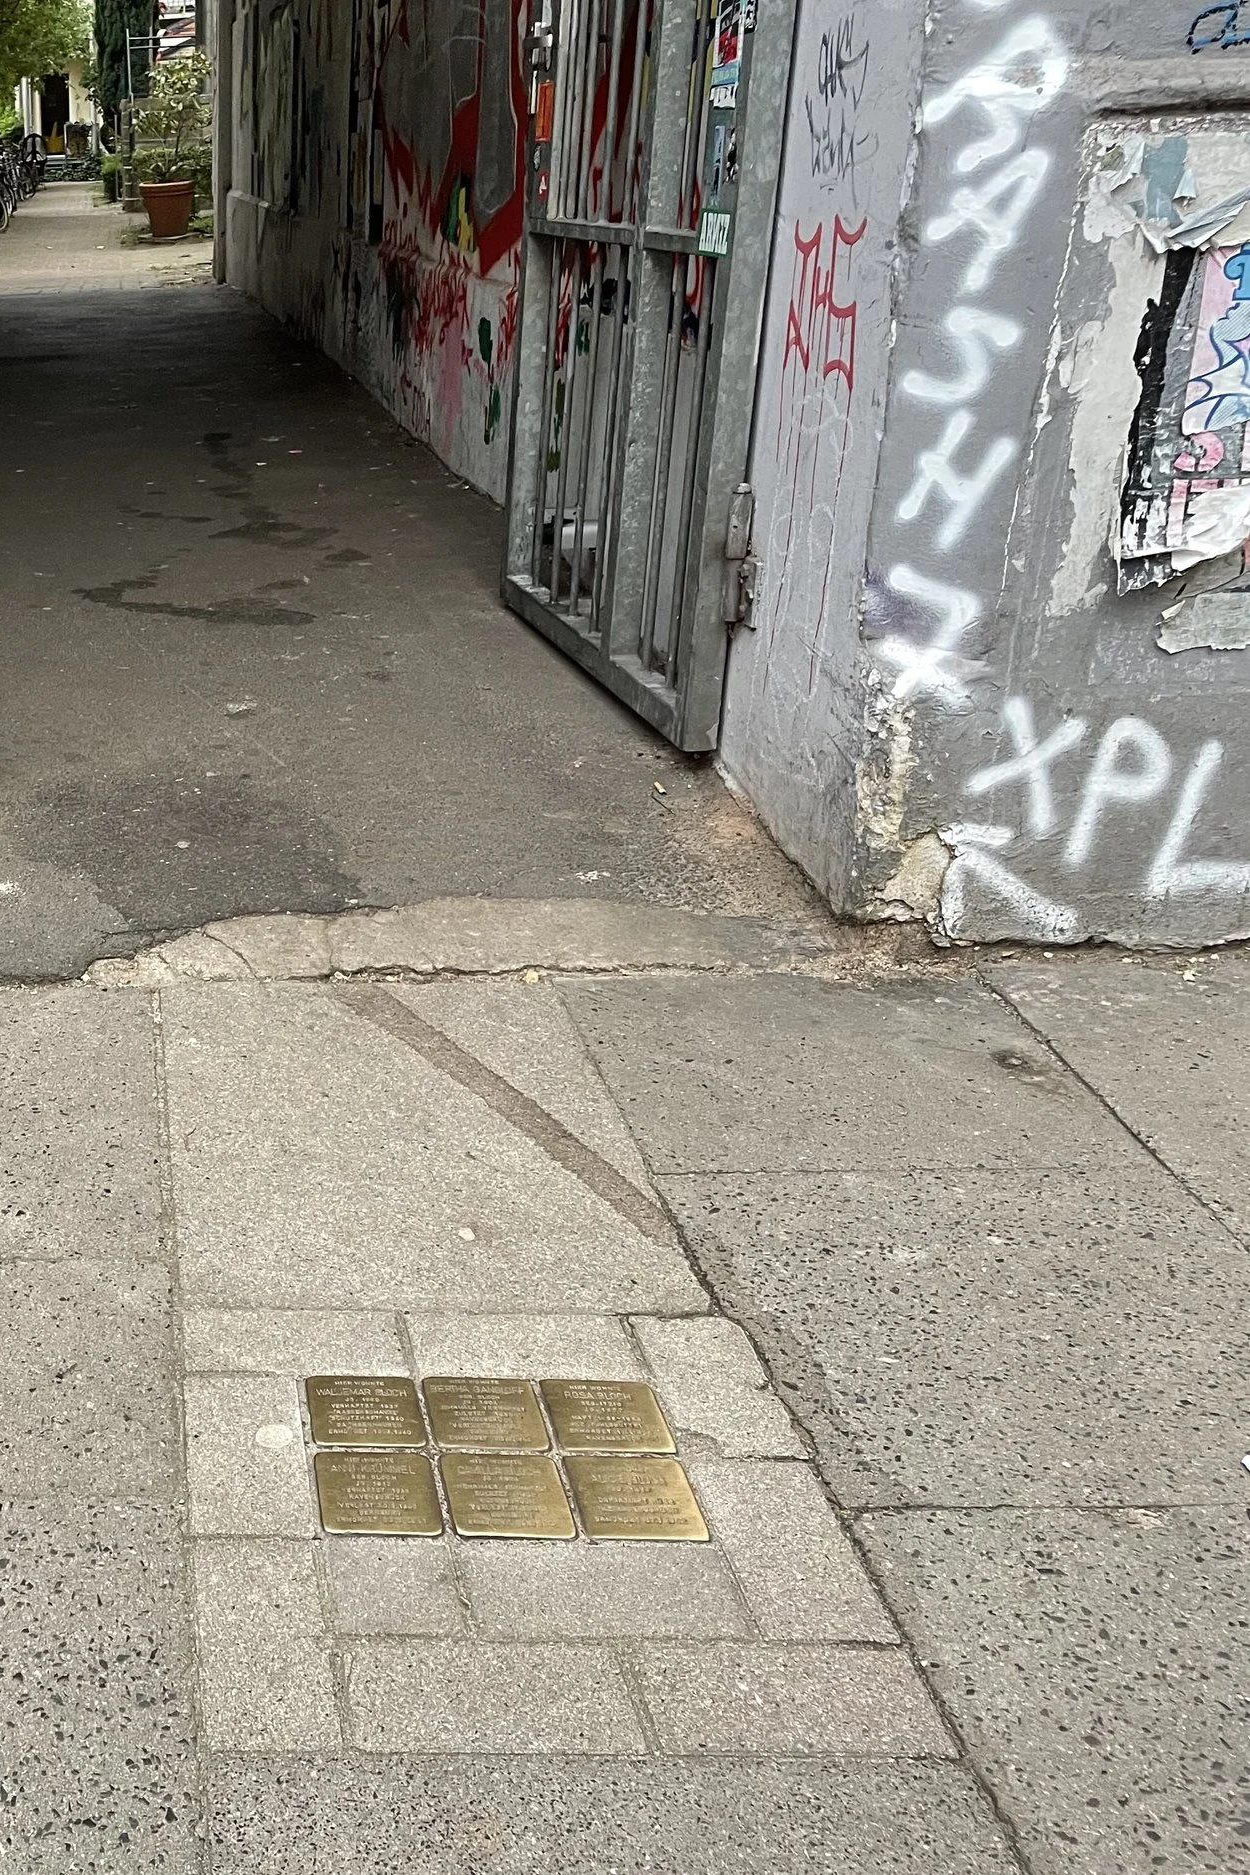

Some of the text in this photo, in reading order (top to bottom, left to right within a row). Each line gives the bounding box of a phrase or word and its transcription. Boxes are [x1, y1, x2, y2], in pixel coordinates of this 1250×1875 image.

[375, 1388, 408, 1397] BLOCH
[430, 1385, 470, 1393] BERTHA
[564, 1391, 595, 1399] ROSA
